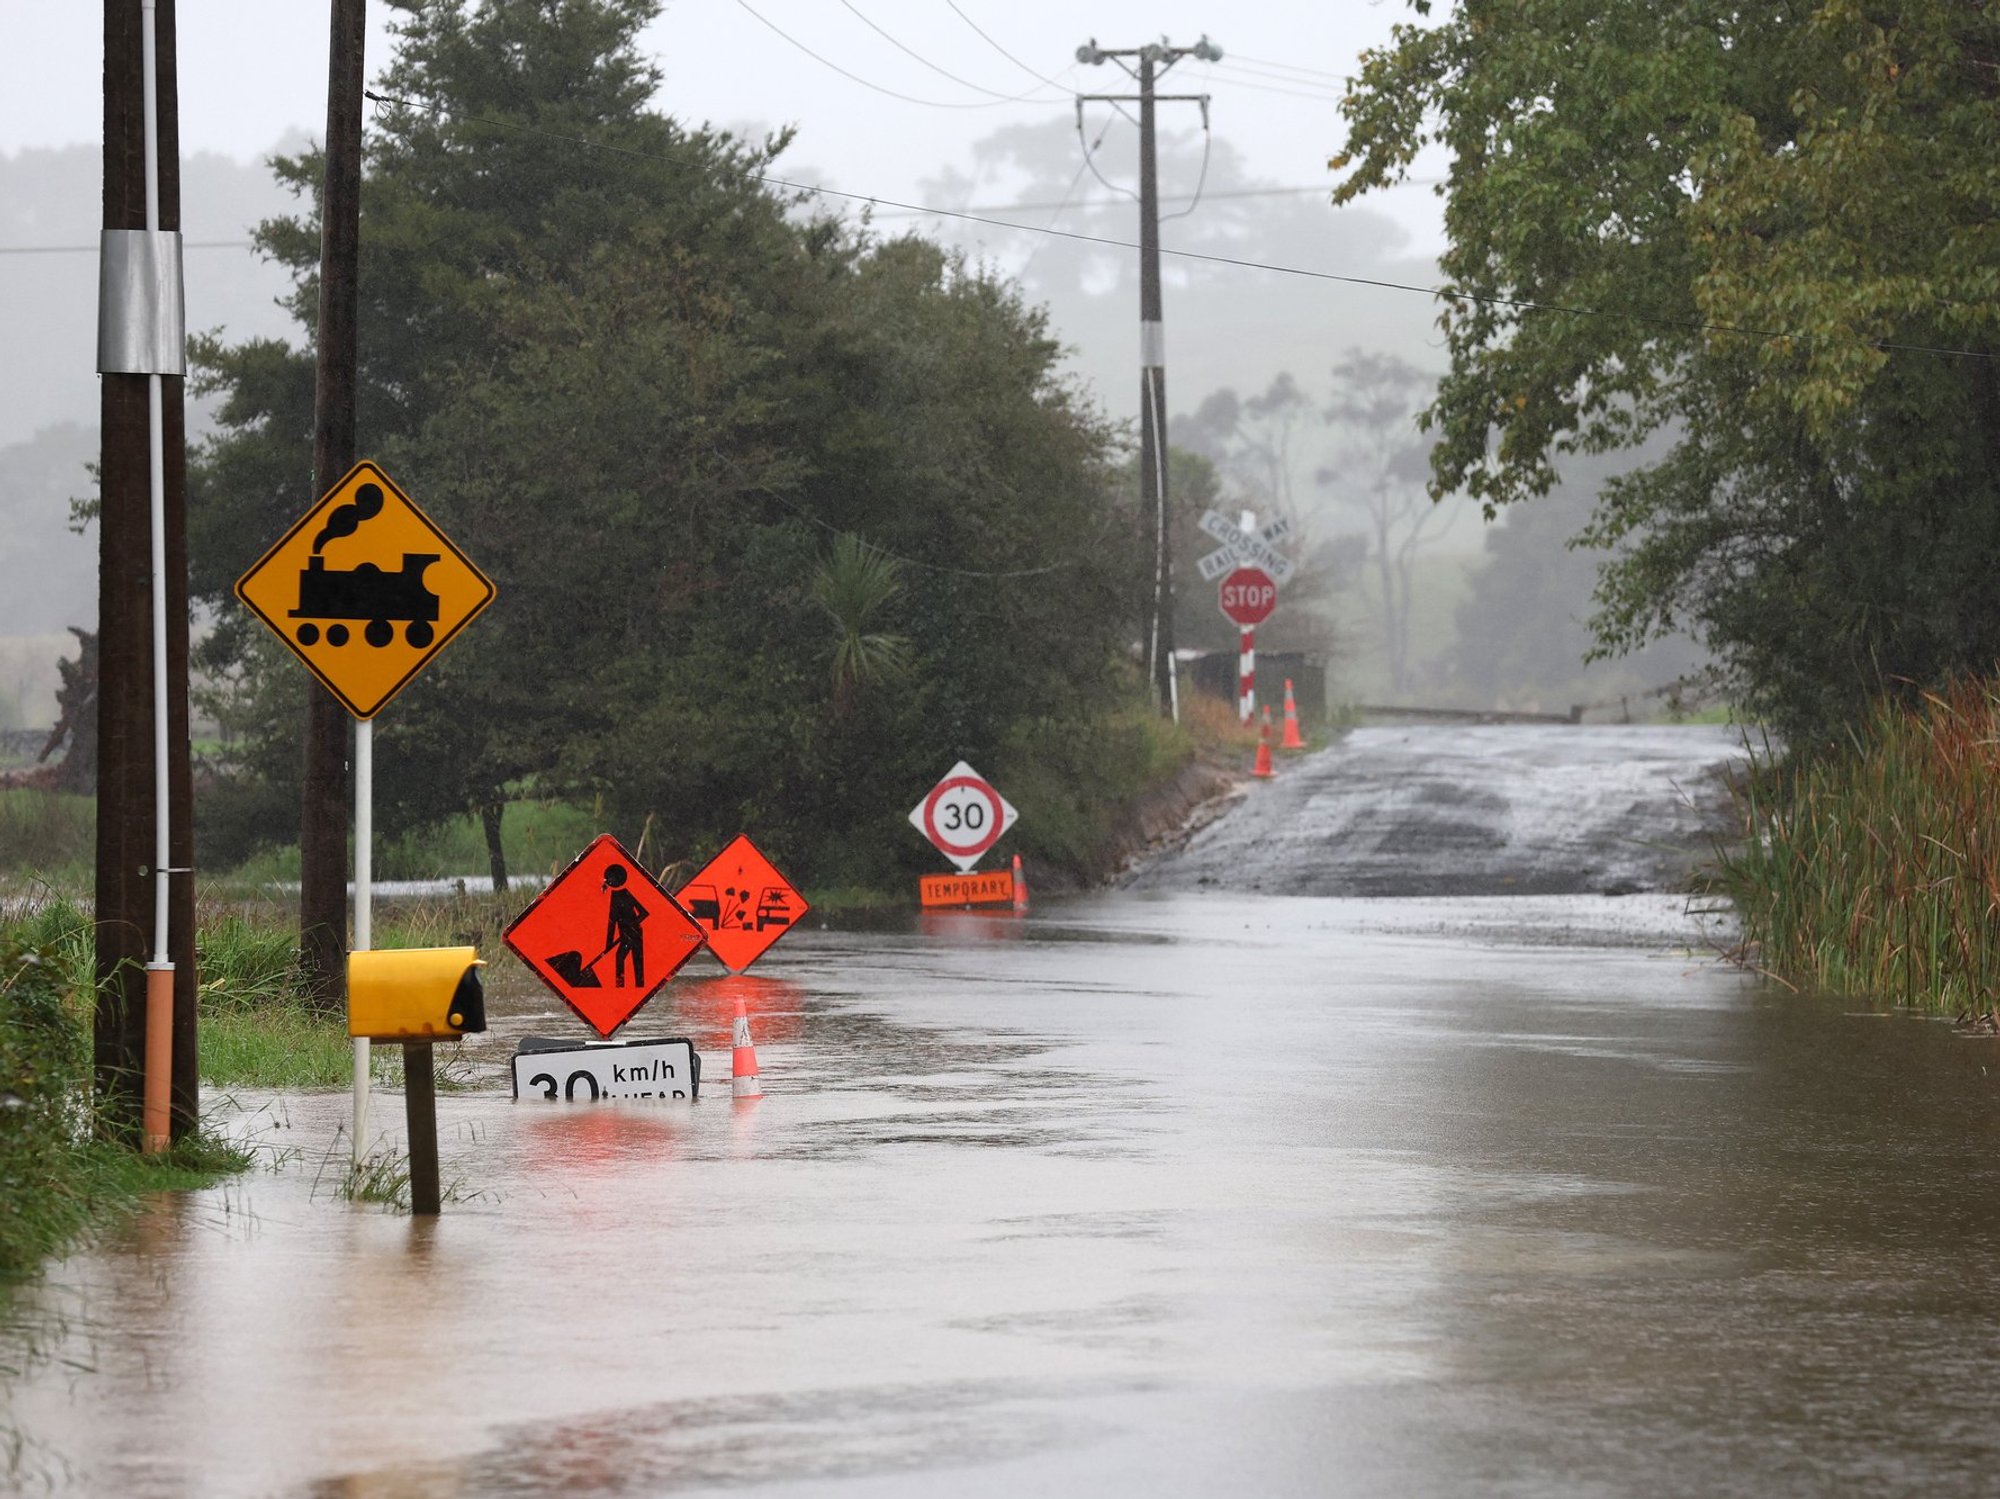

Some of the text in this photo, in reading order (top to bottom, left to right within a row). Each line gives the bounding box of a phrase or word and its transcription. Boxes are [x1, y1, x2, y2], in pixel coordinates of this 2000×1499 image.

[1202, 517, 1290, 577] RAIL WAY
[1207, 515, 1288, 575] CROSSING
[1224, 585, 1274, 608] STOP
[944, 803, 984, 831] 30
[926, 879, 1008, 900] TEMPORARY
[529, 1069, 600, 1099] 30
[613, 1059, 675, 1083] km/h
